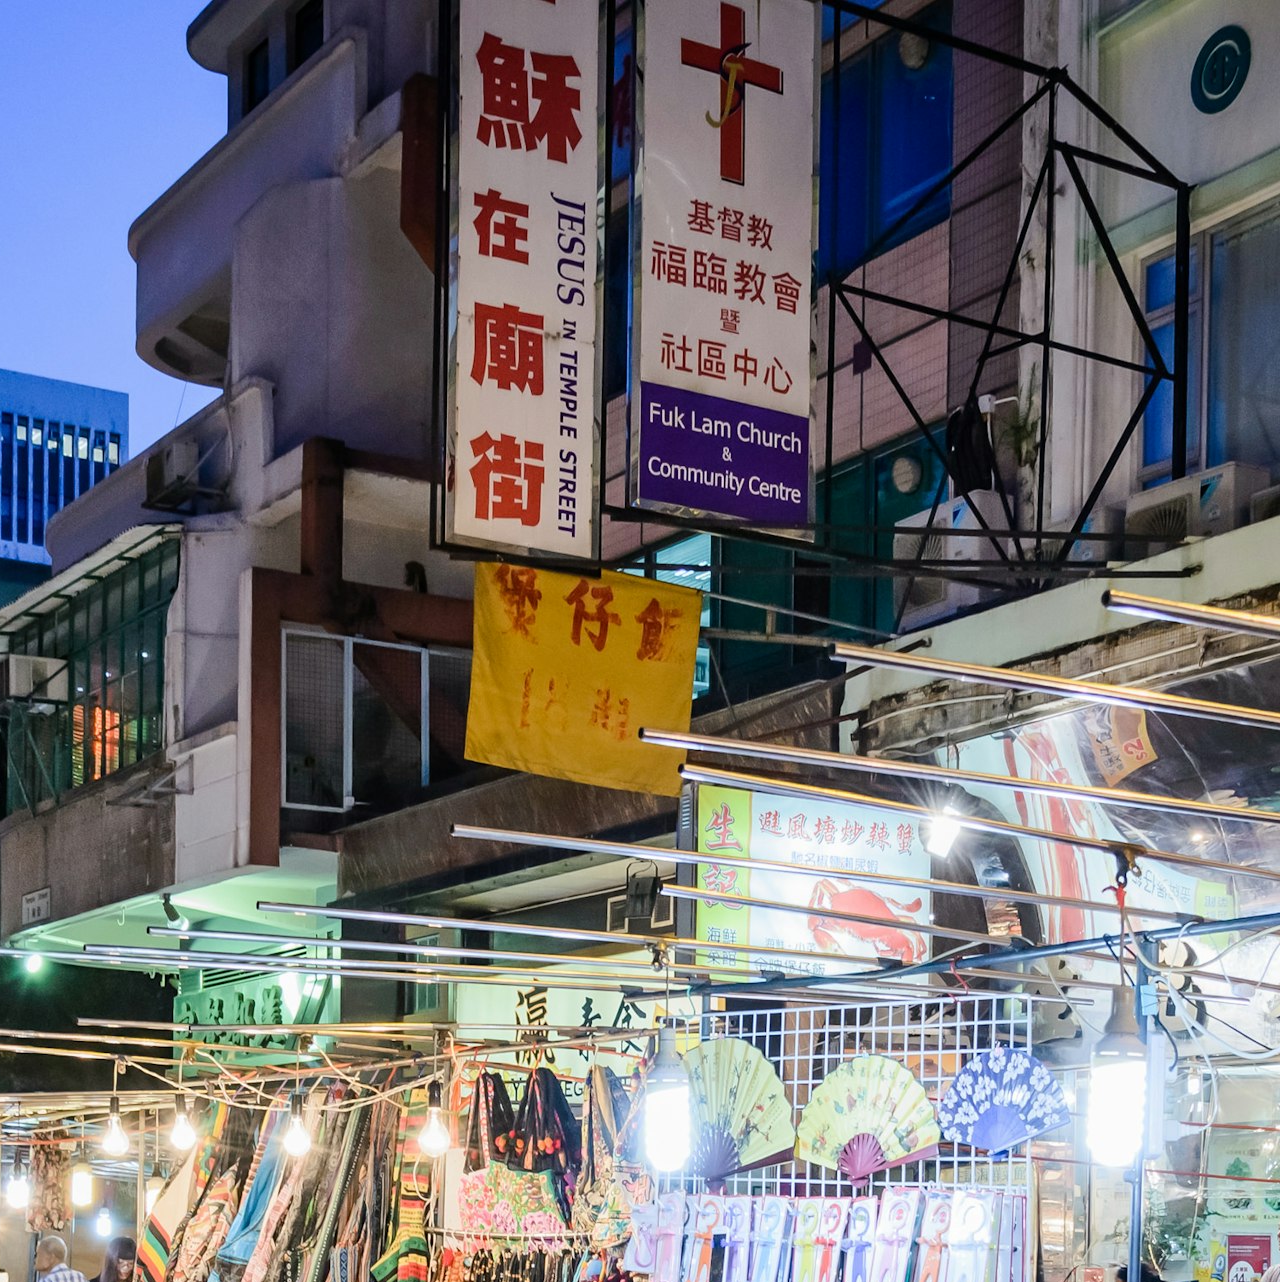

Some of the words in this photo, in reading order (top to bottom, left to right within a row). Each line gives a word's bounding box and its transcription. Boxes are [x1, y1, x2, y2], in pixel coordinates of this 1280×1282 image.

[551, 190, 586, 307] JESUS
[687, 199, 774, 251] 基督教
[469, 0, 583, 527] 穌在廟街
[651, 240, 803, 315] 福臨教會
[562, 320, 577, 341] IN
[719, 308, 742, 336] 暨
[660, 332, 794, 397] 社區中心
[559, 352, 578, 439] TEMPLE
[649, 402, 685, 430] Fuk
[691, 410, 732, 440] Lam
[737, 419, 802, 455] Church
[721, 446, 733, 463] &
[558, 450, 577, 538] STREET
[648, 456, 745, 496] Community
[748, 473, 802, 504] Centre
[704, 802, 744, 911] 生記
[758, 809, 916, 856] 避風塘炒辣蟹
